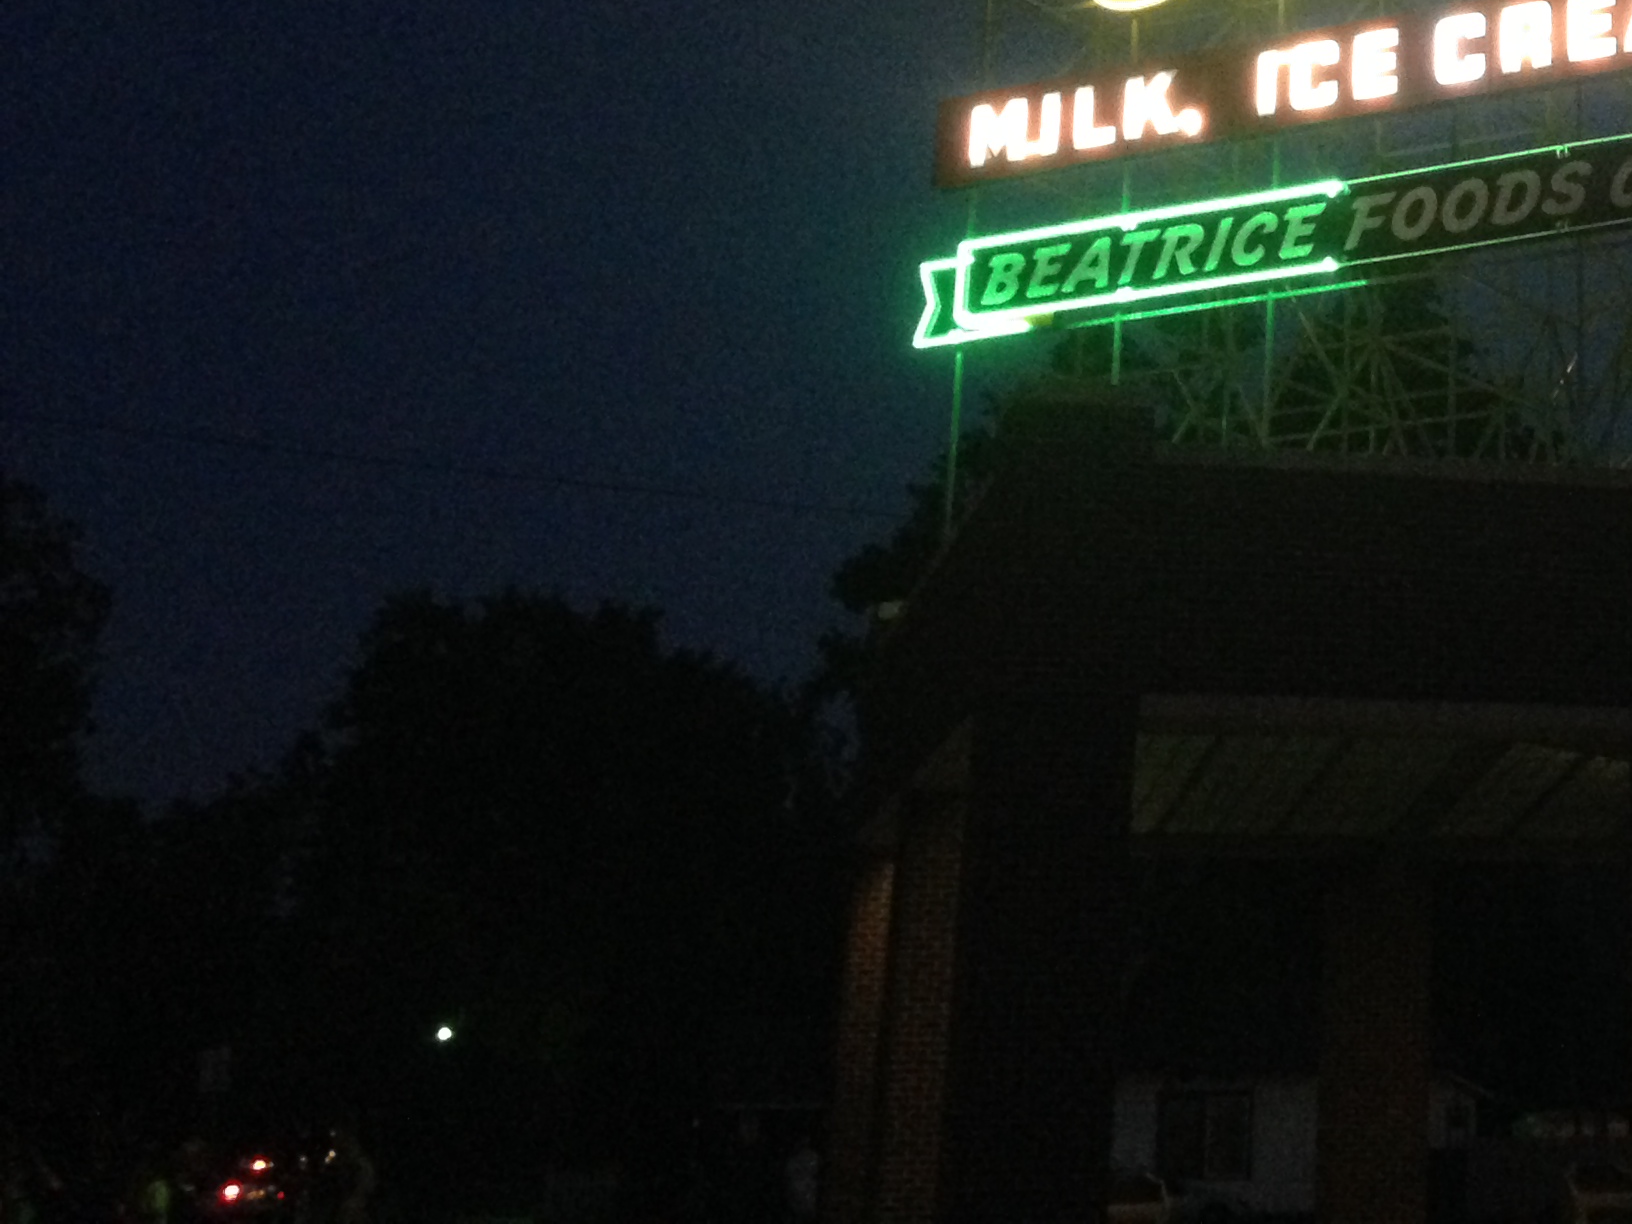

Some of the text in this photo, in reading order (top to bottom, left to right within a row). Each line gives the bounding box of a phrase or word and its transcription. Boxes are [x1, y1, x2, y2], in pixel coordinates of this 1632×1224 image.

[1255, 26, 1400, 117] ICE
[979, 201, 1328, 307] BEATRICE
[1343, 159, 1588, 252] FOODS
